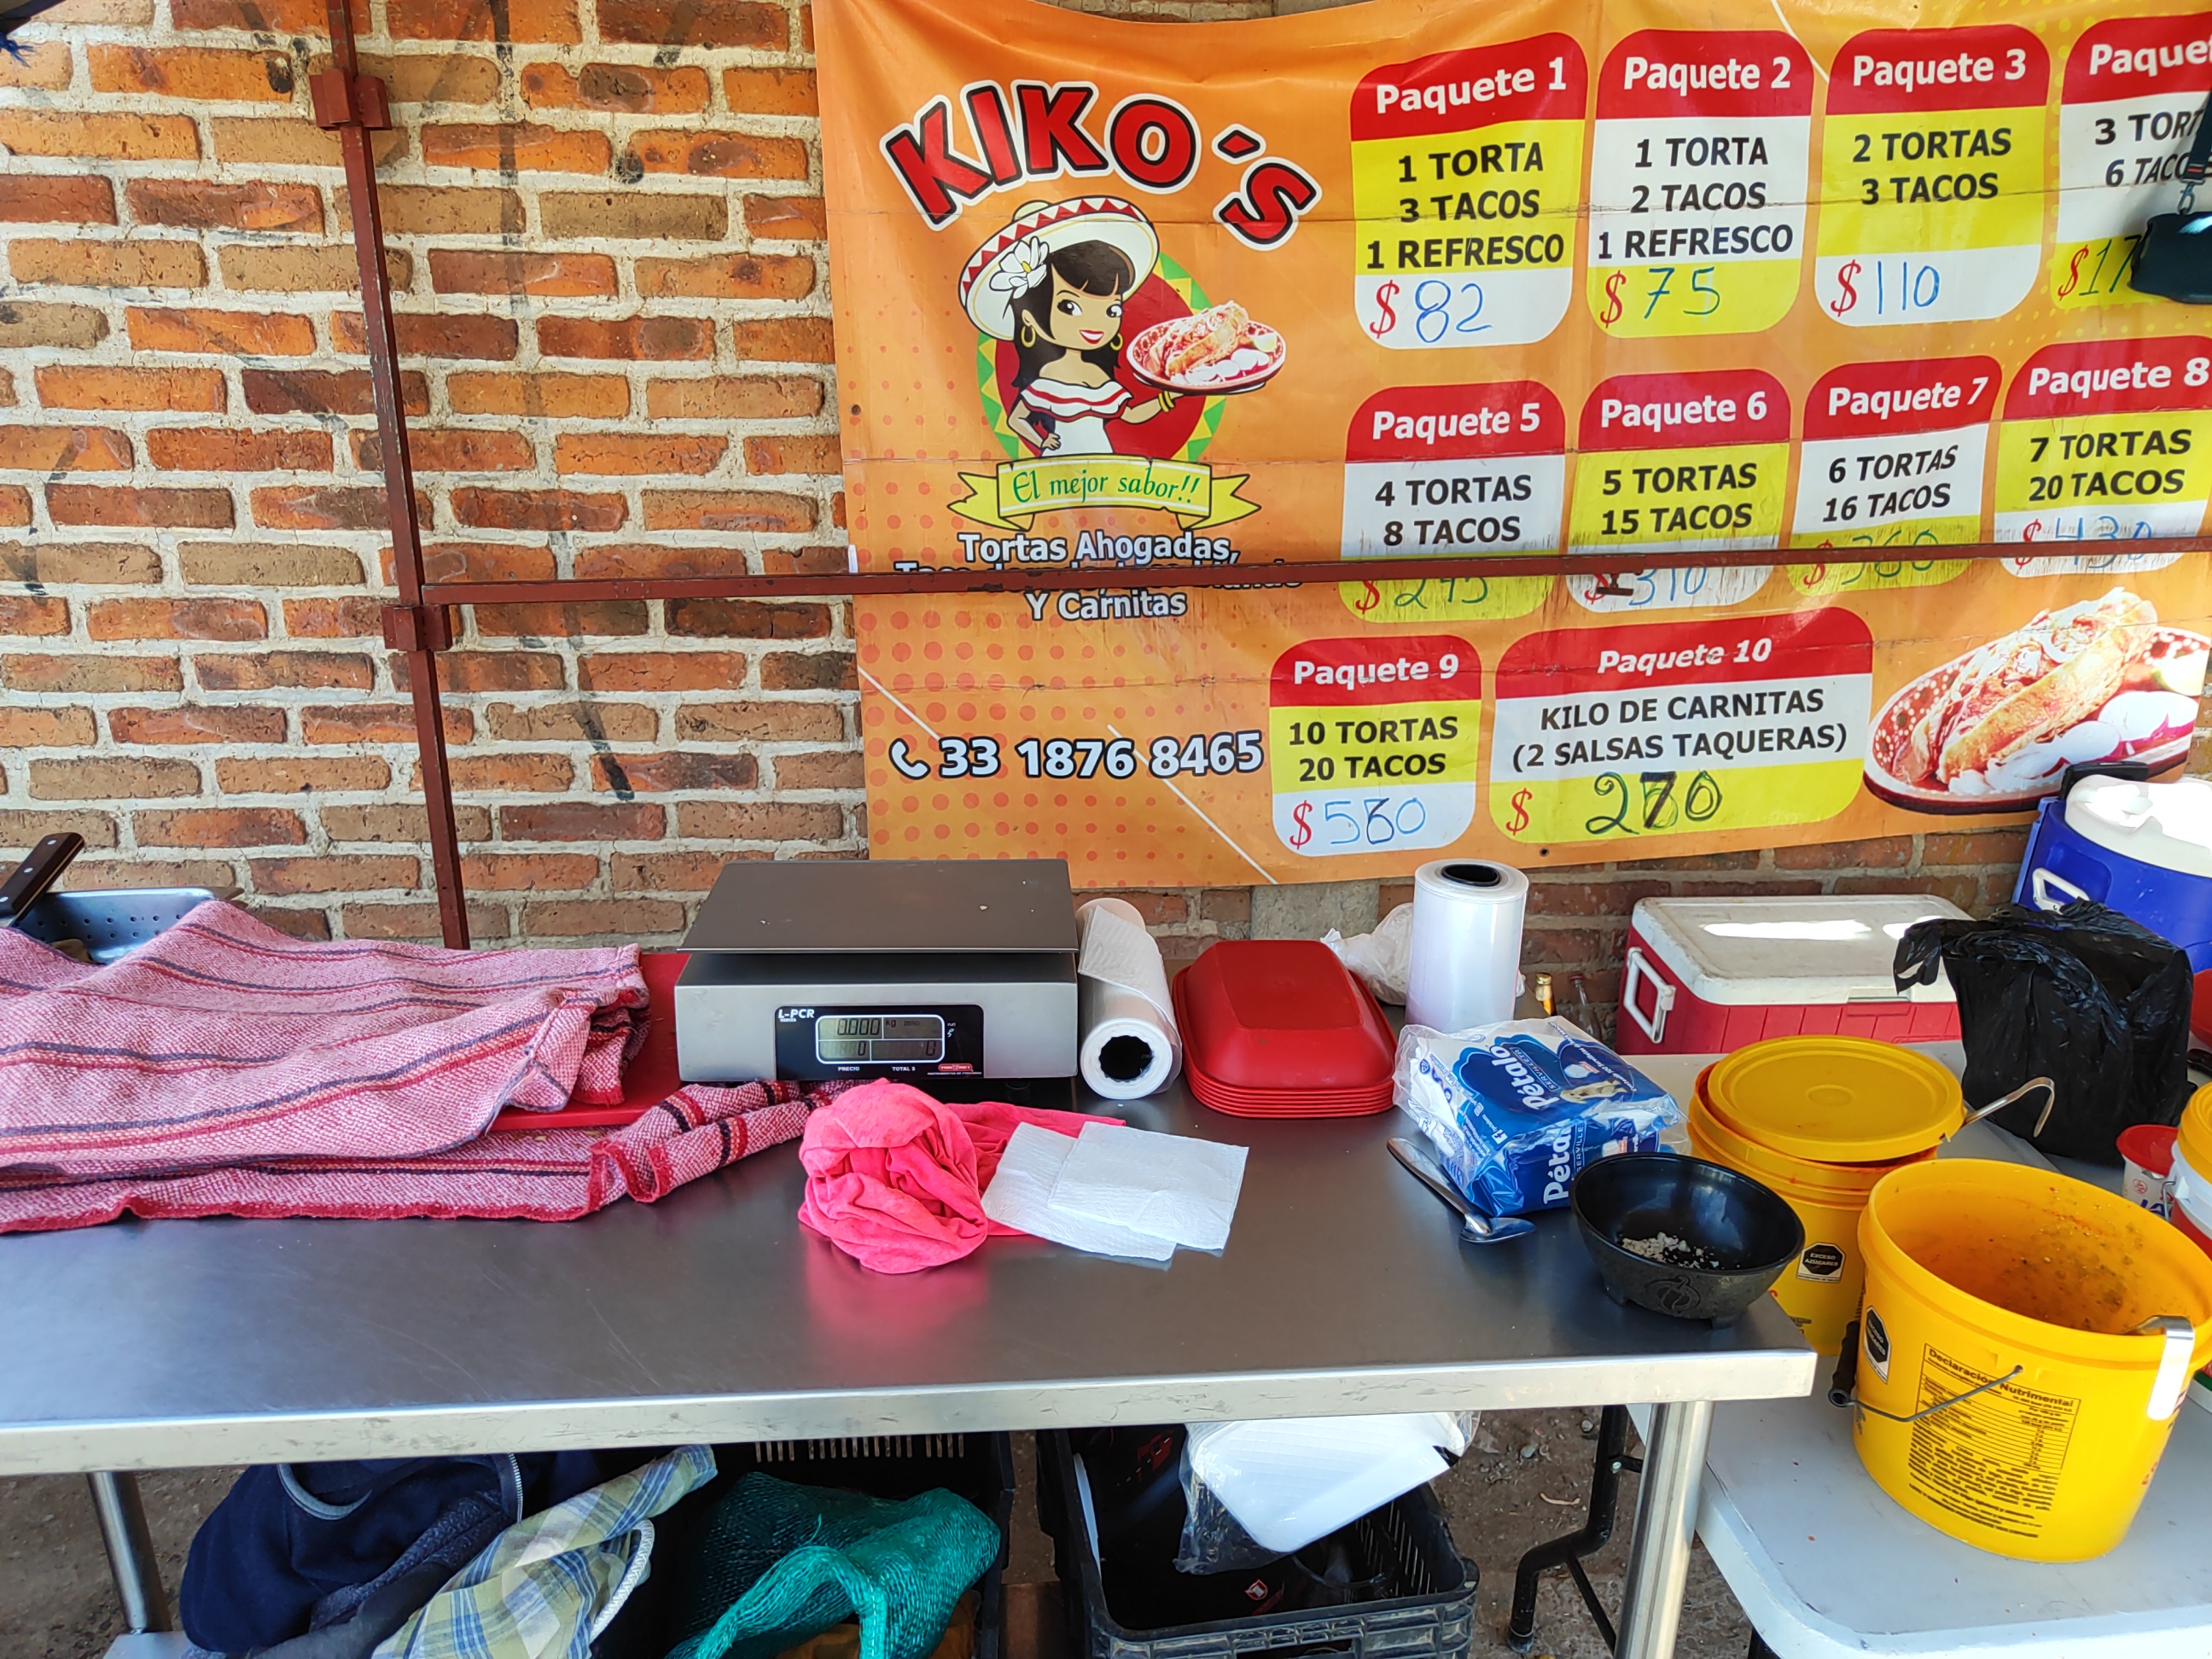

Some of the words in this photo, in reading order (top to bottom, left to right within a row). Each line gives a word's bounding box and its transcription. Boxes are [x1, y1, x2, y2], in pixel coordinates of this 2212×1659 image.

[1377, 64, 1535, 114] Paquete
[1548, 56, 1568, 90] 1
[1623, 56, 1761, 100] Paquete
[1771, 57, 1791, 89] 2
[1853, 53, 1994, 93] Paquete
[2004, 49, 2027, 80] 3
[2095, 118, 2116, 145] 3
[2128, 108, 2204, 143] TORT
[1399, 154, 1417, 183] 1
[1429, 141, 1544, 181] TORTA
[1634, 139, 1653, 168] 1
[1665, 137, 1769, 167] TORTA
[1852, 134, 1871, 163] 2
[1881, 128, 2012, 161] TORTAS
[1861, 178, 1879, 206] 3
[1889, 172, 1999, 204] TACOS
[2105, 159, 2125, 187] 6
[1400, 197, 1419, 223] 3
[1432, 189, 1540, 221] TACOS
[1631, 185, 1650, 213] 2
[1661, 182, 1767, 212] TACOS
[1366, 241, 1384, 269] 1
[1398, 233, 1564, 269] REFRESCO
[1598, 232, 1612, 260] 1
[1624, 224, 1794, 259] REFRESCO
[2029, 362, 2172, 399] Paquete
[2184, 357, 2210, 387] 8
[1601, 394, 1737, 433] Paquete
[1746, 391, 1767, 421] 6
[1828, 381, 1961, 420] Paquete
[1965, 376, 1989, 405] 7
[1372, 406, 1511, 445] Paquete
[1520, 402, 1541, 432] 5
[2029, 437, 2050, 463] 7
[2058, 429, 2192, 460] TORTAS
[1602, 469, 1622, 496] 5
[1632, 463, 1757, 494] TORTAS
[1829, 457, 1846, 484] 6
[1855, 445, 1959, 481] TORTAS
[1012, 471, 1040, 503] El
[1050, 470, 1109, 503] mejor
[1118, 467, 1201, 504] sabor!!
[1375, 480, 1395, 507] 4
[1406, 474, 1533, 507] TORTAS
[1822, 497, 1857, 522] 16
[1867, 483, 1951, 518] TACOS
[2029, 474, 2064, 502] 20
[2070, 469, 2186, 498] TACOS
[1383, 521, 1404, 546] 8
[1414, 515, 1521, 546] TACOS
[1600, 509, 1639, 536] 15
[1650, 503, 1753, 533] TACOS
[958, 532, 1068, 562] Tortas
[1075, 529, 1240, 565] Ahogadas,
[1025, 590, 1051, 620] Y
[1057, 587, 1188, 621] Carnitas
[1293, 655, 1429, 691] Paquete
[1439, 655, 1459, 681] 9
[1597, 645, 1725, 676] Paquete
[1733, 637, 1772, 663] 10
[1540, 701, 1610, 731] KILO
[1620, 697, 1657, 725] DE
[1667, 688, 1825, 722] CARNITAS
[1288, 720, 1326, 747] 10
[1336, 716, 1458, 745] TORTAS
[1512, 739, 1545, 773] (2
[1554, 733, 1665, 767] SALSAS
[1673, 723, 1848, 759] TAQUERAS)
[939, 736, 1001, 777] 33
[1016, 738, 1137, 778] 1876
[1149, 731, 1264, 778] 8465
[1299, 756, 1336, 783] 20
[1345, 753, 1447, 780] TACOS
[777, 1008, 815, 1019] L-PCR
[1489, 1045, 1560, 1110] Pétalo
[1513, 1048, 1557, 1091] SERVILLETA
[1543, 1118, 1571, 1204] Pétal
[1575, 1121, 1585, 1172] SERVILLE
[1810, 1252, 1837, 1260] EXCESO
[1999, 1382, 2075, 1408] Nutrimental
